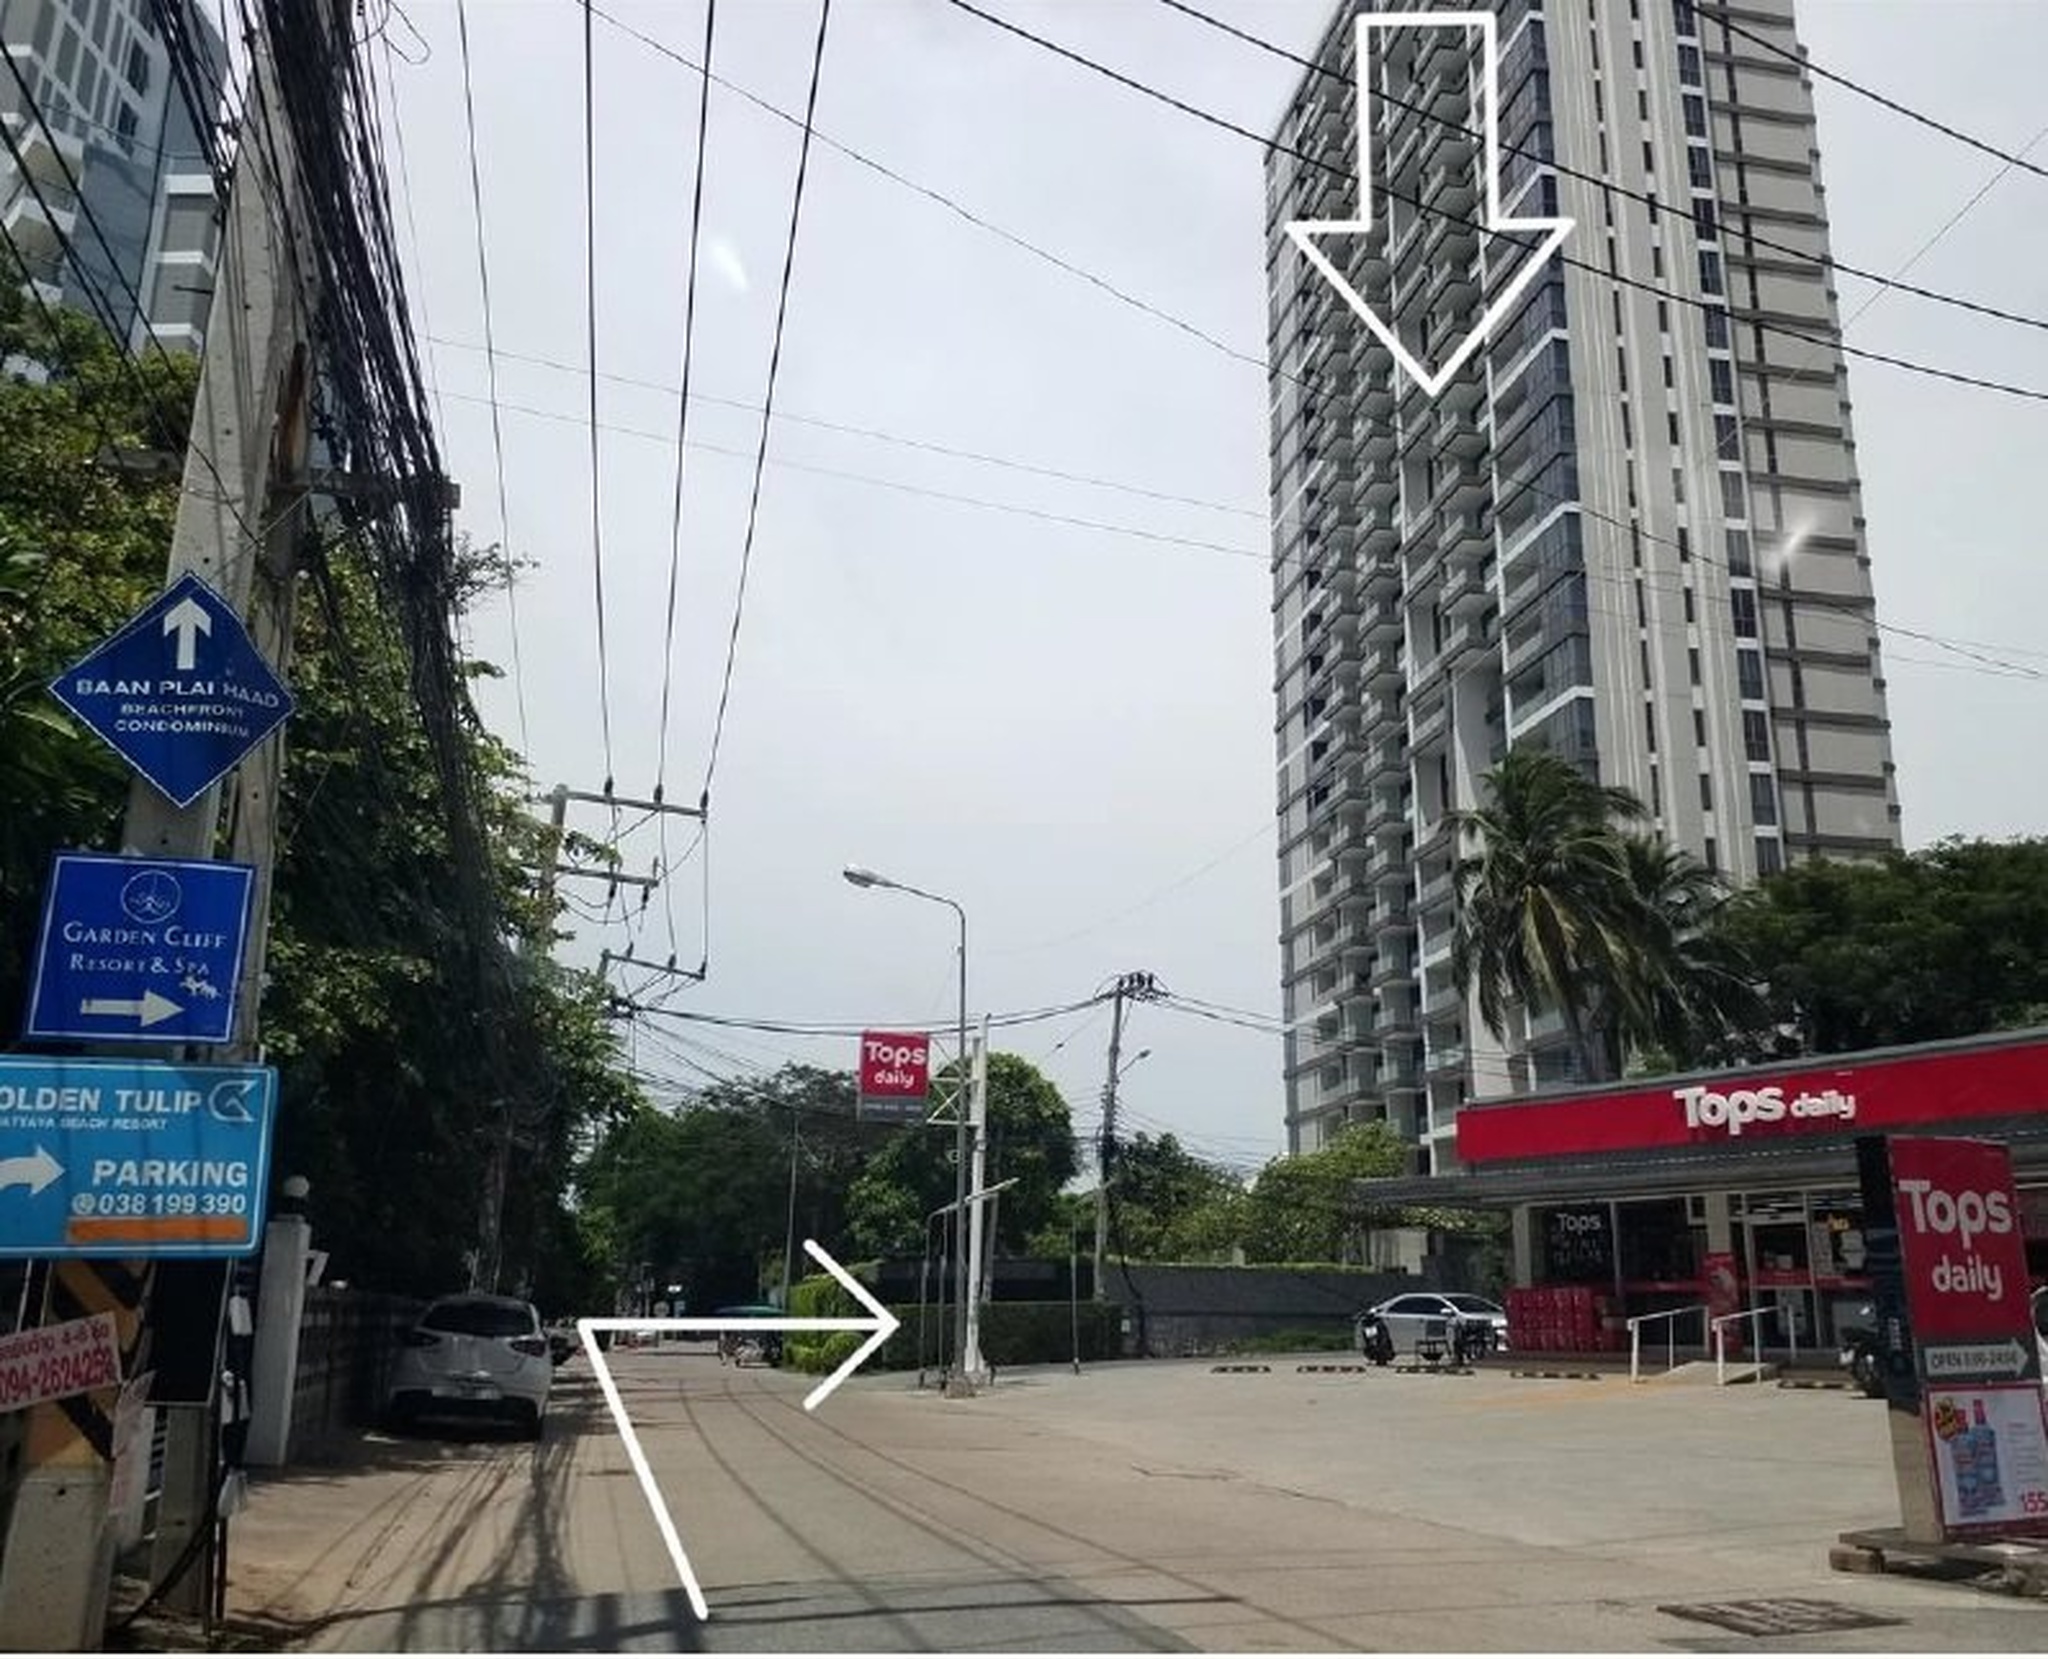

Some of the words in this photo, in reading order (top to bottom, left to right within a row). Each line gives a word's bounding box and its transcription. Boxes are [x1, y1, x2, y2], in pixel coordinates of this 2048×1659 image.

[76, 680, 150, 695] BAAN
[159, 680, 214, 695] PLAI
[223, 682, 279, 708] HAAD
[121, 704, 244, 718] BEACHFRONT
[114, 719, 249, 738] CONDOMINIUM
[865, 1041, 927, 1069] Tops
[874, 1069, 915, 1089] daily
[115, 1089, 203, 1113] TULIP
[1673, 1085, 1787, 1136] Tops
[1790, 1089, 1857, 1120] daily
[60, 1117, 108, 1131] BEACH
[112, 1118, 168, 1131] RESORT
[92, 1159, 249, 1187] PARKING
[150, 1193, 197, 1215] 199
[201, 1194, 247, 1215] 390
[1898, 1179, 2014, 1250] Tops
[1556, 1212, 1601, 1236] Tops
[1932, 1254, 2003, 1301] daily
